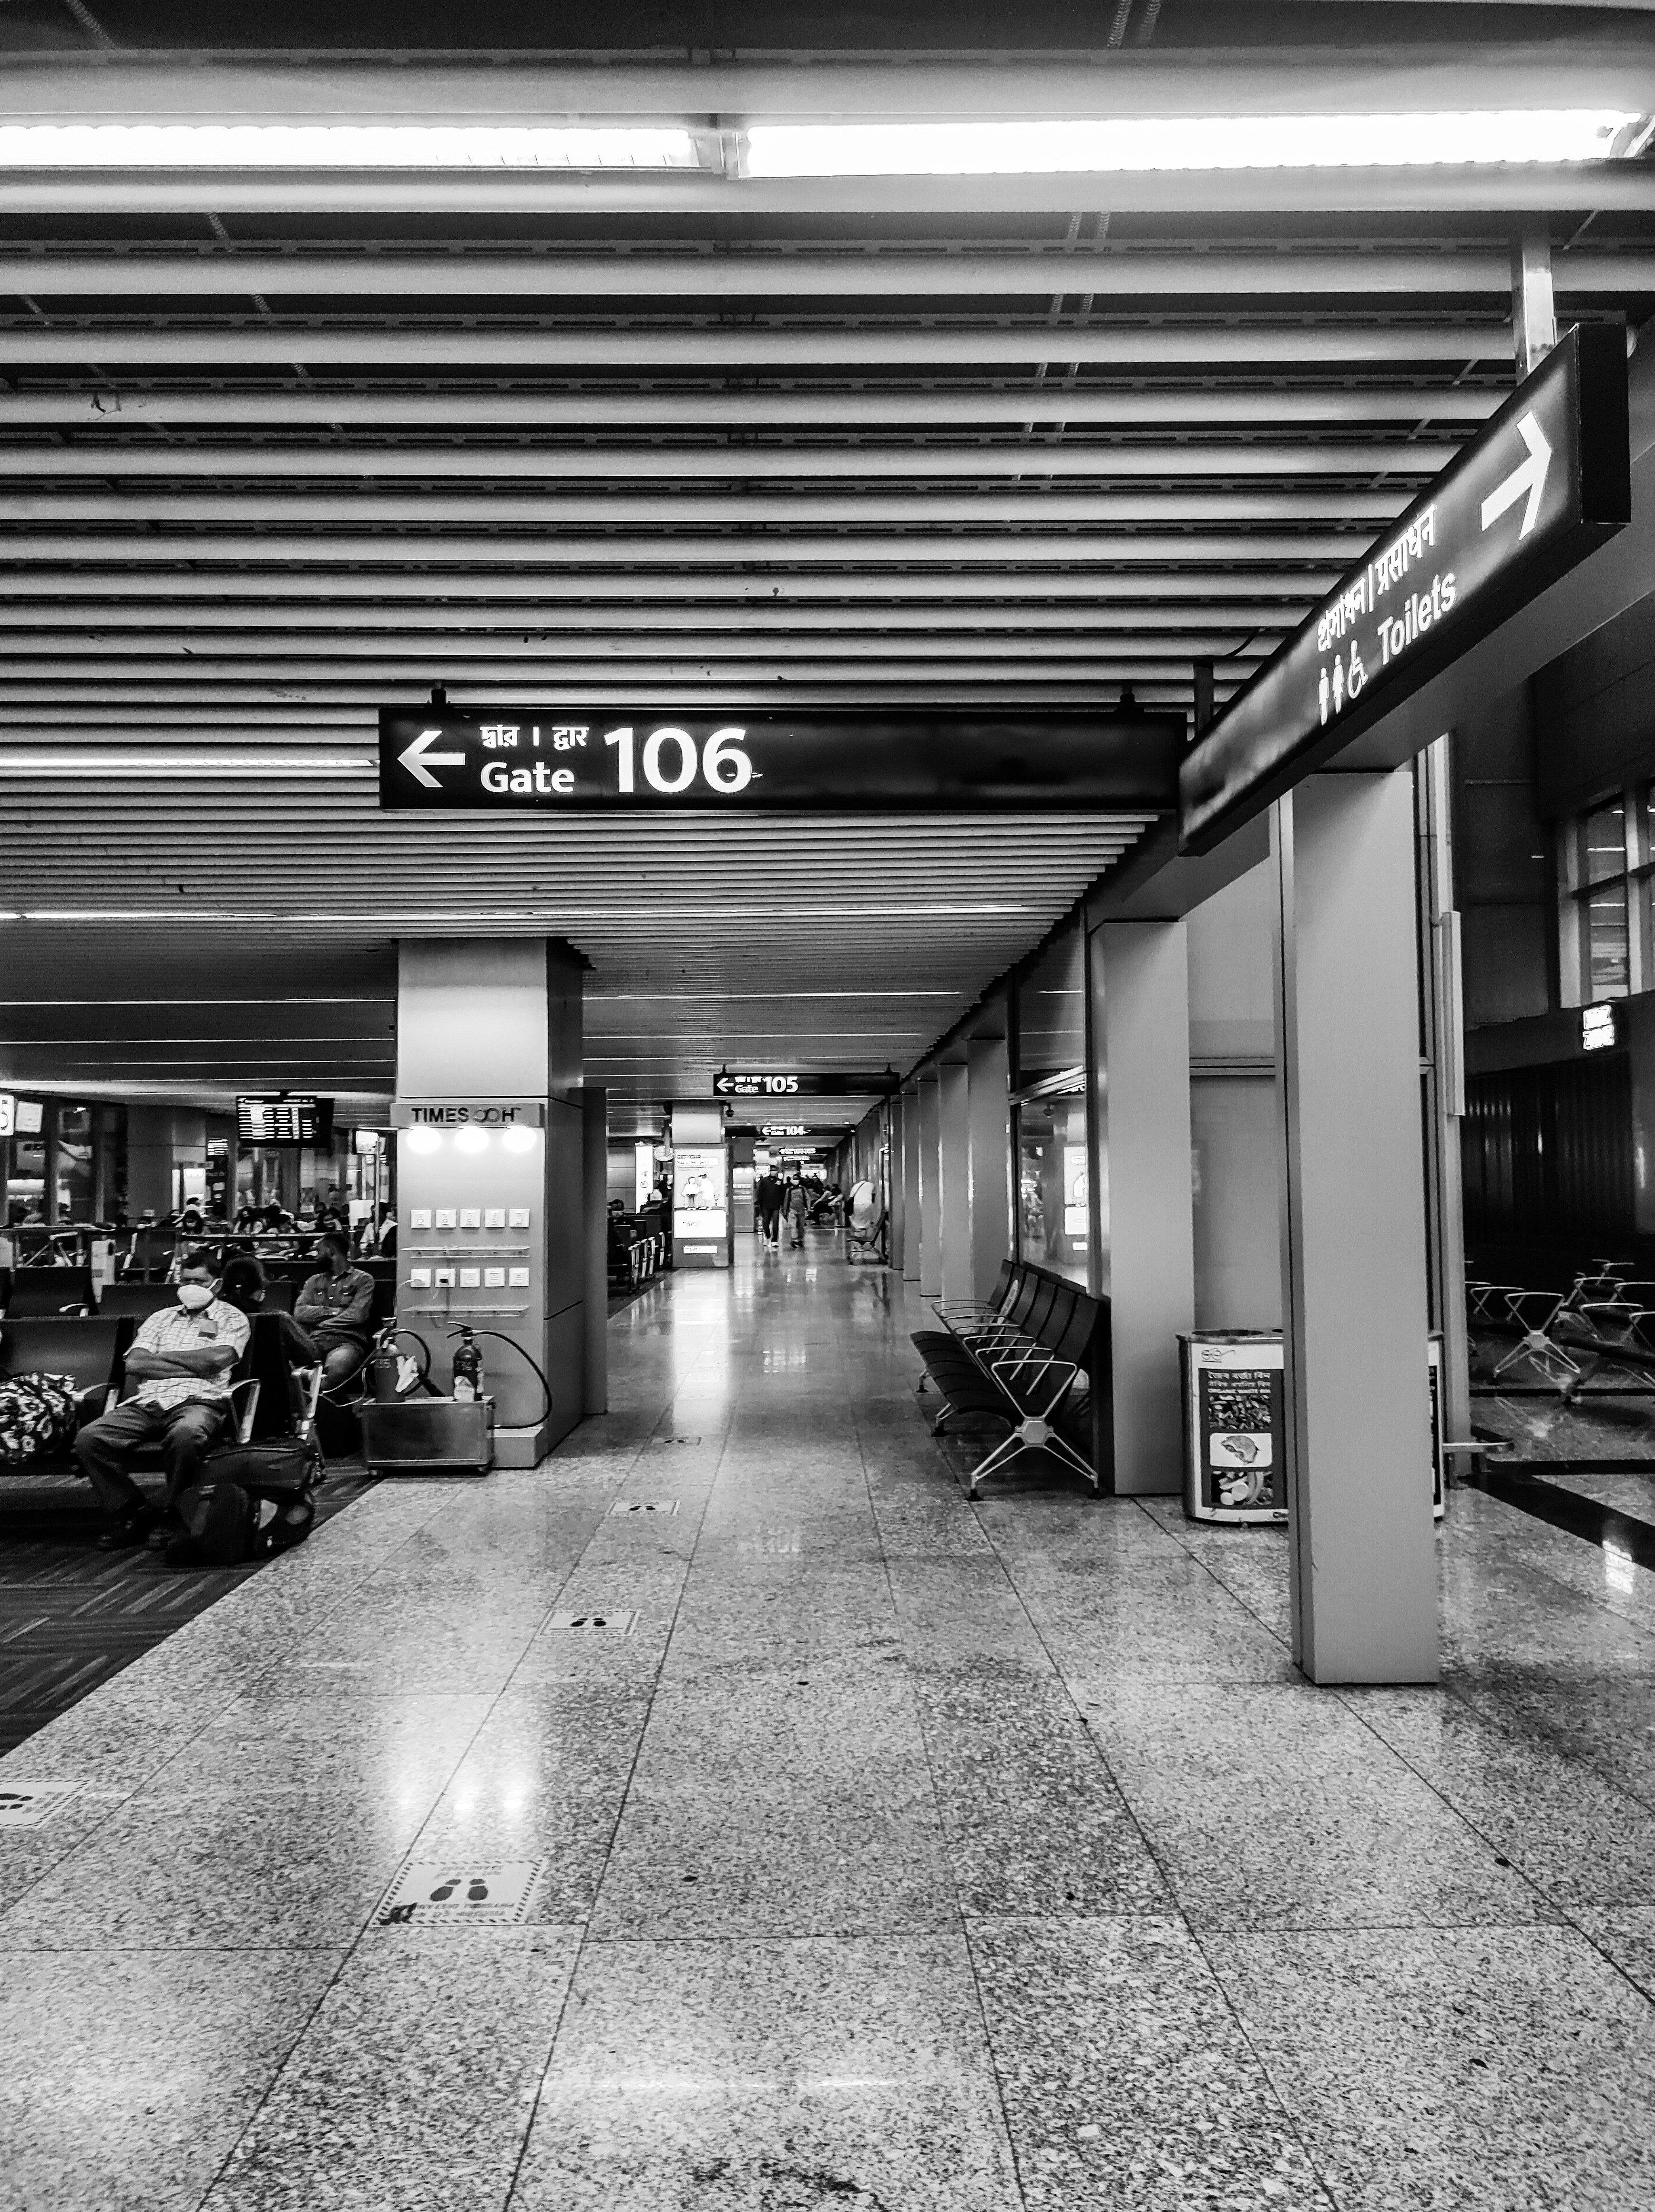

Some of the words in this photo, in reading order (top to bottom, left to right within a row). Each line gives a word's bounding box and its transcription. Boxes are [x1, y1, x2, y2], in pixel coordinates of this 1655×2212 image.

[1374, 504, 1435, 595] प्रसाधन
[1378, 573, 1456, 666] Toilets
[480, 724, 520, 748] দ্বার
[552, 727, 589, 750] द्वार
[480, 761, 575, 793] Gate
[604, 727, 752, 793] 106
[735, 1085, 759, 1093] Gate
[763, 1076, 798, 1093] 105
[411, 1107, 470, 1123] TIMES
[785, 1126, 805, 1135] 104
